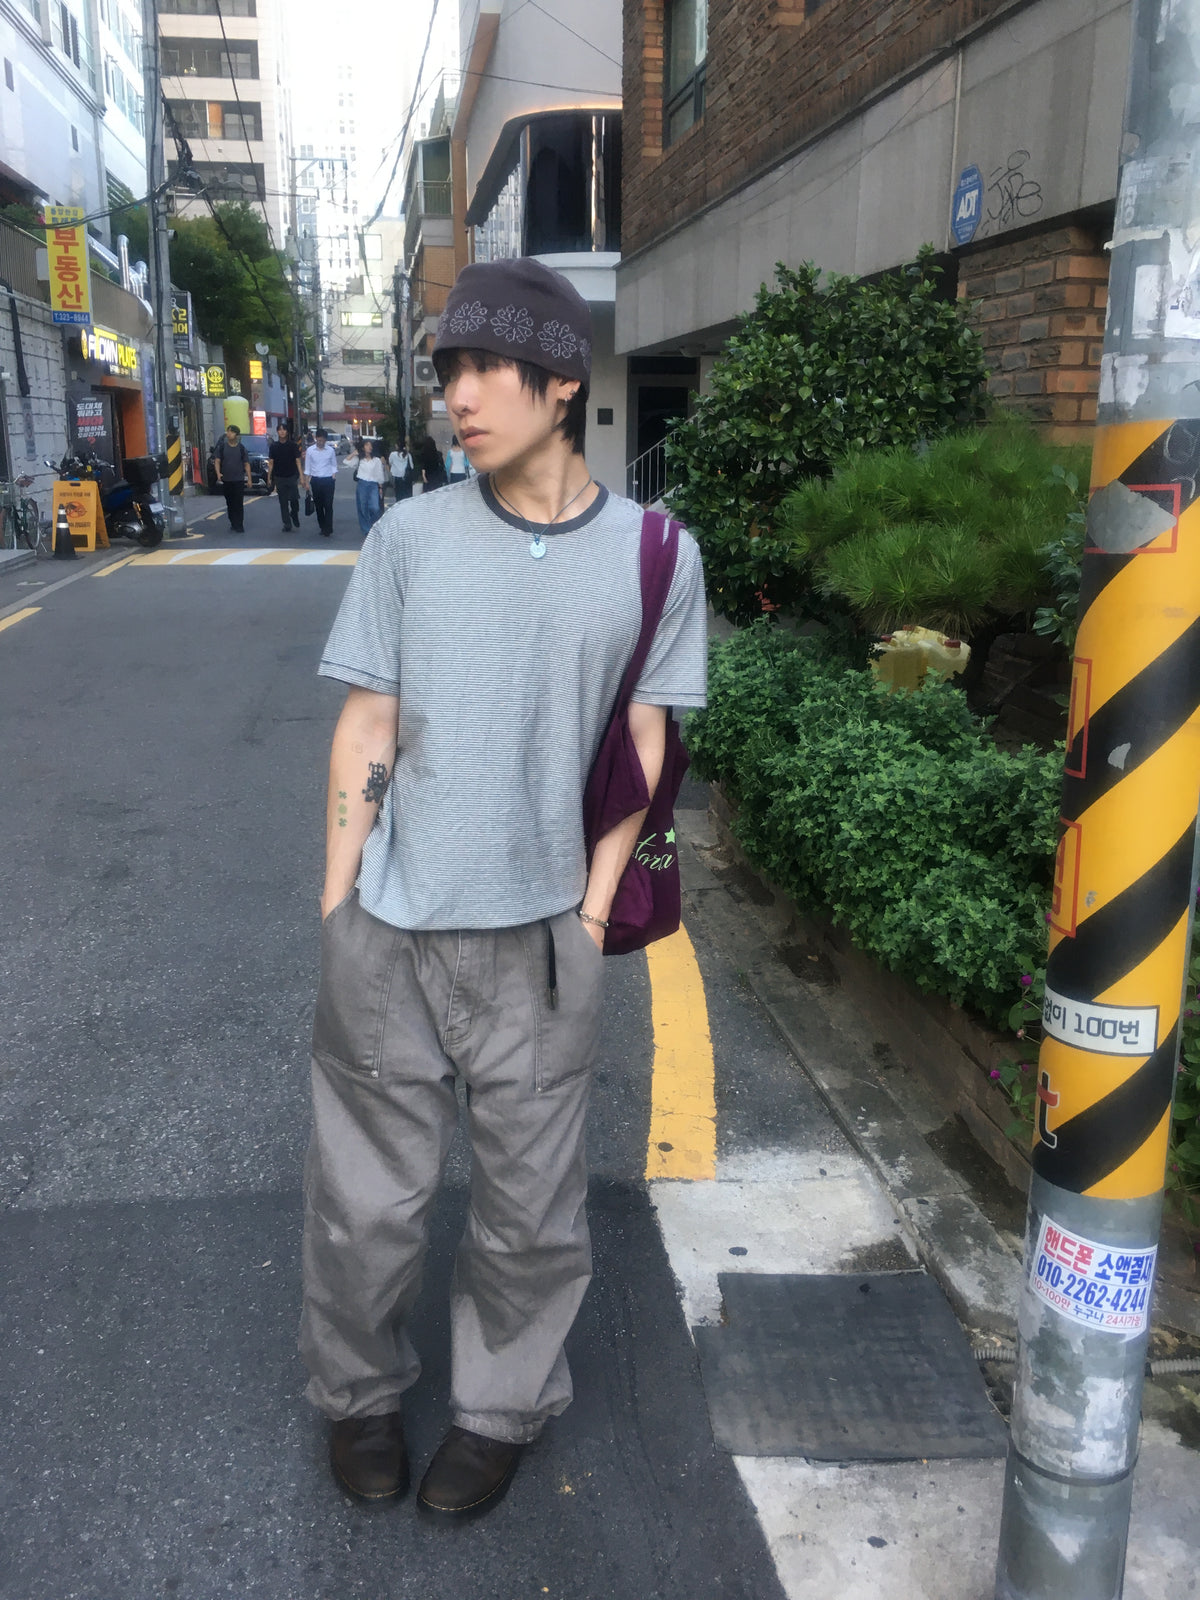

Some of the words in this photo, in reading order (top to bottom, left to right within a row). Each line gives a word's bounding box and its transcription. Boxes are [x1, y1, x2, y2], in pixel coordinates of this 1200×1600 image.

[956, 189, 979, 221] ADT
[53, 227, 84, 309] 부동산
[1074, 1012, 1140, 1045] 100번
[1044, 1226, 1095, 1275] 핸드폰
[1037, 1254, 1147, 1312] 010-2262-4244
[1073, 1304, 1104, 1323] 누구나
[1105, 1314, 1141, 1327] 24시가능
